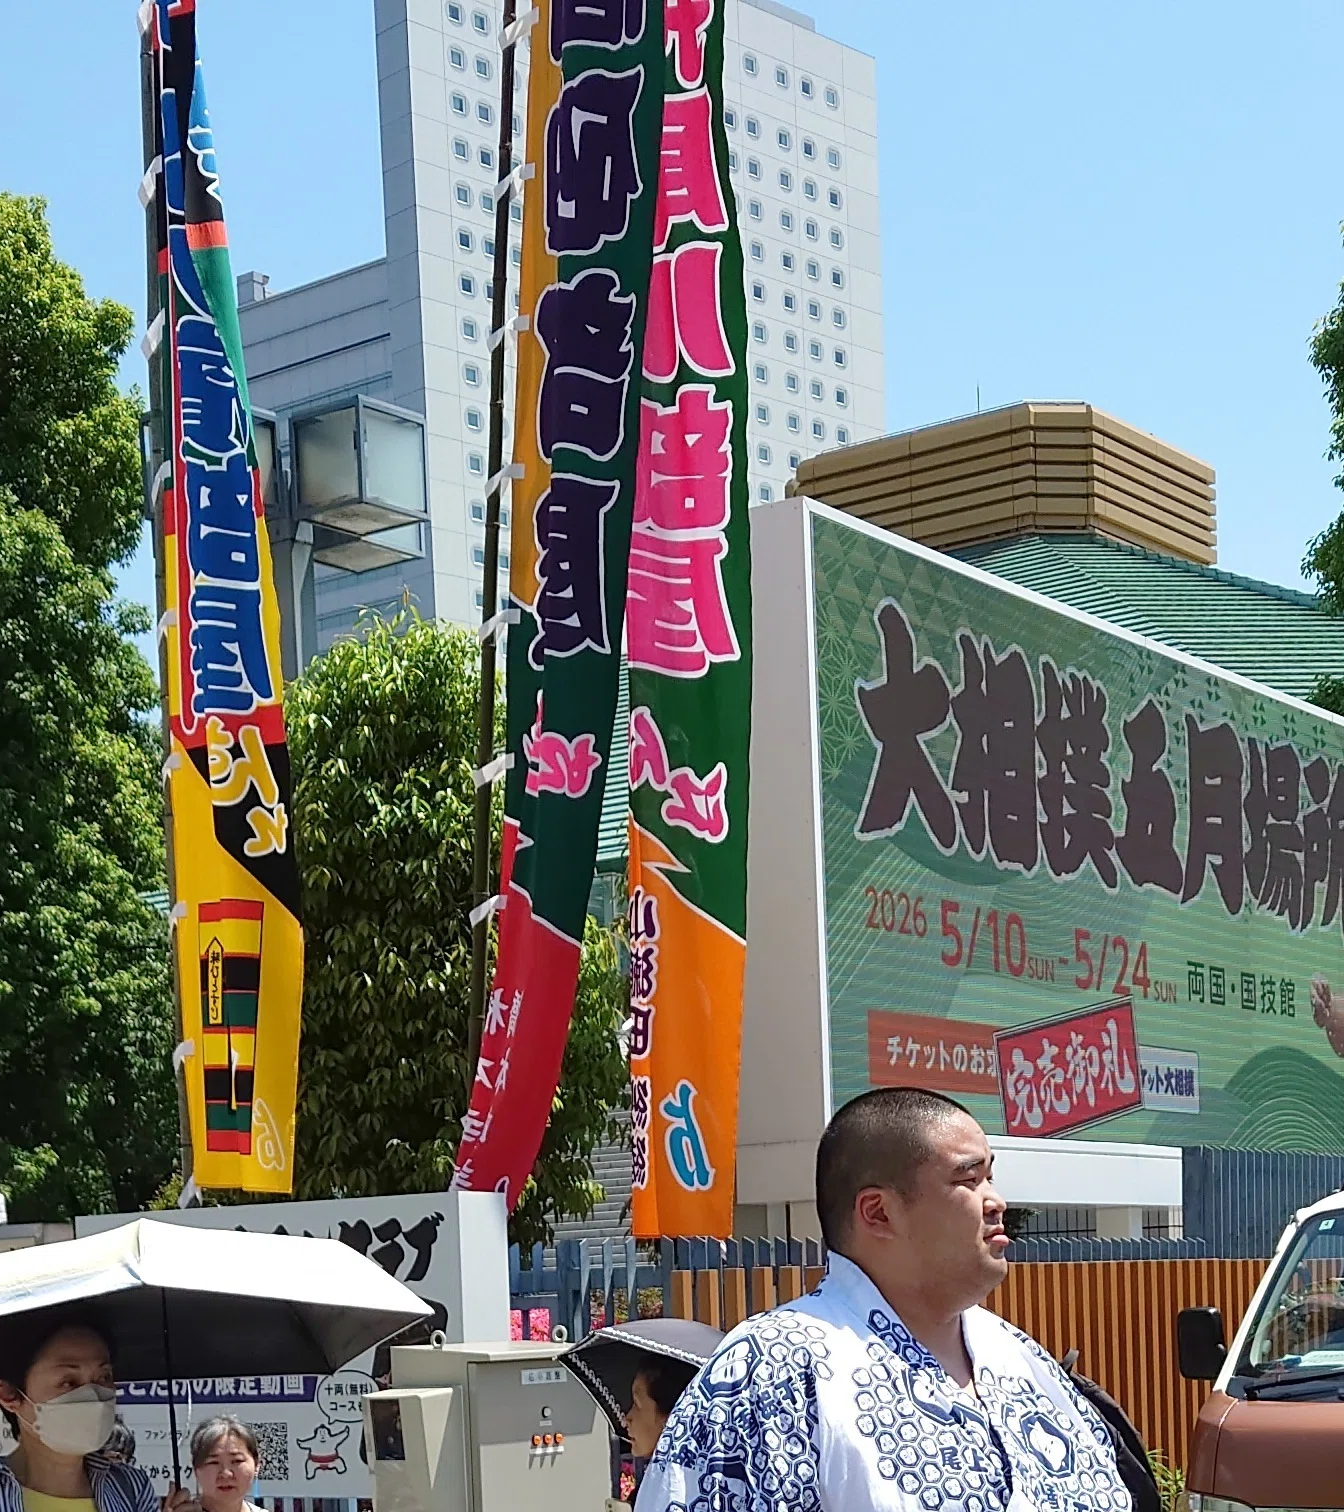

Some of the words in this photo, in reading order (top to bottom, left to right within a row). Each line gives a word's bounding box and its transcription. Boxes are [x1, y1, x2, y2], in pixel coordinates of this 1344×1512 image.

[864, 885, 928, 938] 2026
[940, 899, 1027, 977] 5/10
[1027, 956, 1055, 982] SUN
[1073, 927, 1150, 999] 5/24
[1154, 979, 1177, 1004] SUN
[1187, 961, 1297, 1018] 両国・国技館
[1006, 1018, 1135, 1130] 完売御礼
